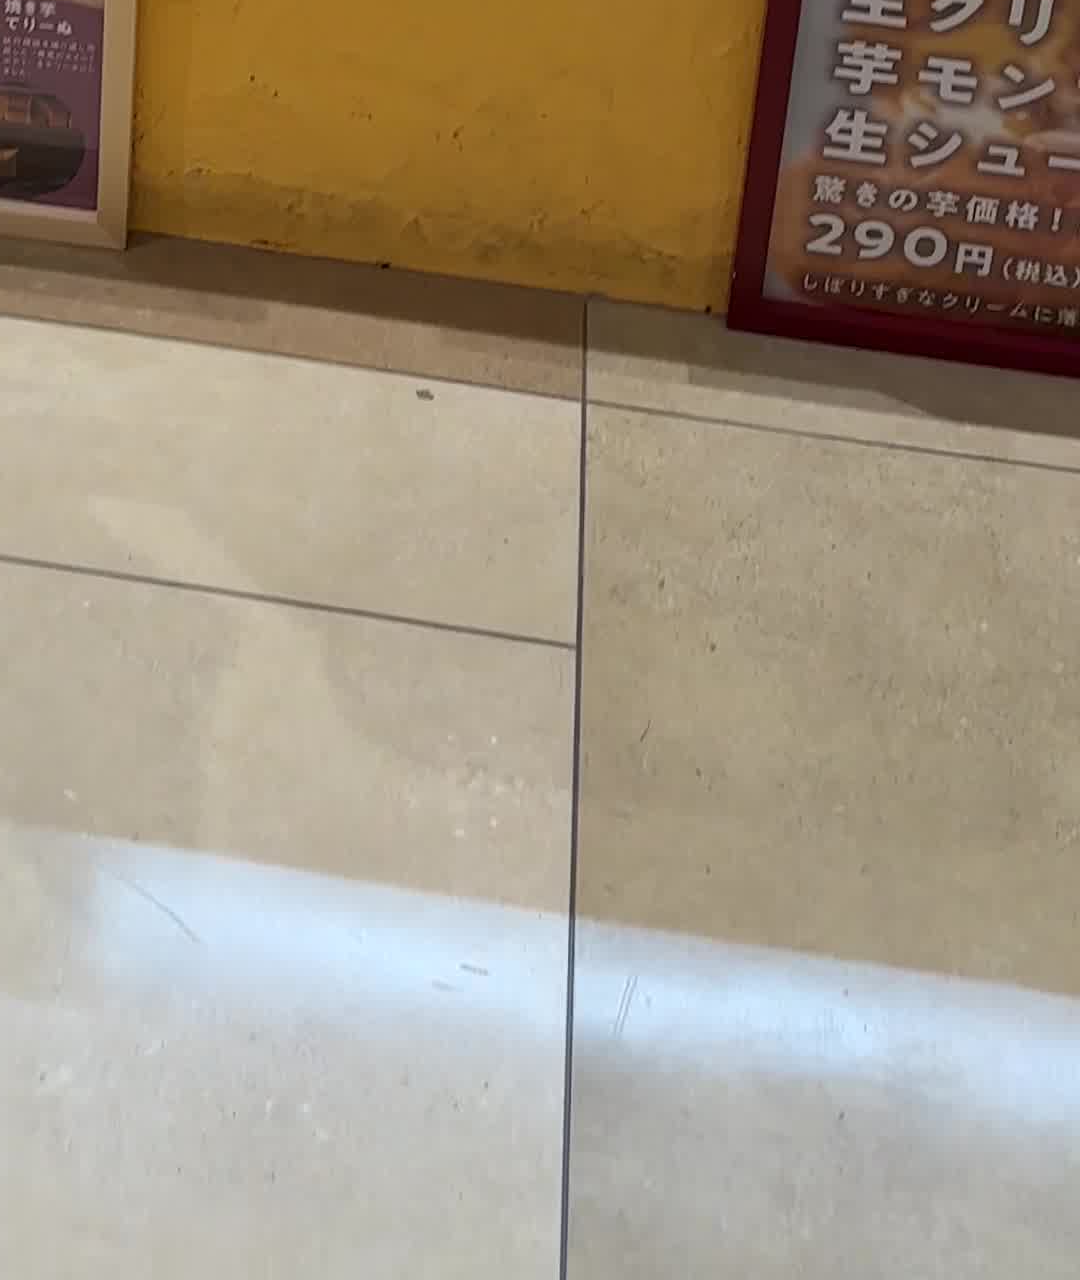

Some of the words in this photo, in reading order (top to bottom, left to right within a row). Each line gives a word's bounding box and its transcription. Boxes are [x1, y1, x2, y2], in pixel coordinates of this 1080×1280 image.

[832, 40, 1056, 111] 芋モン
[812, 174, 1063, 233] 驚きの芋価格！
